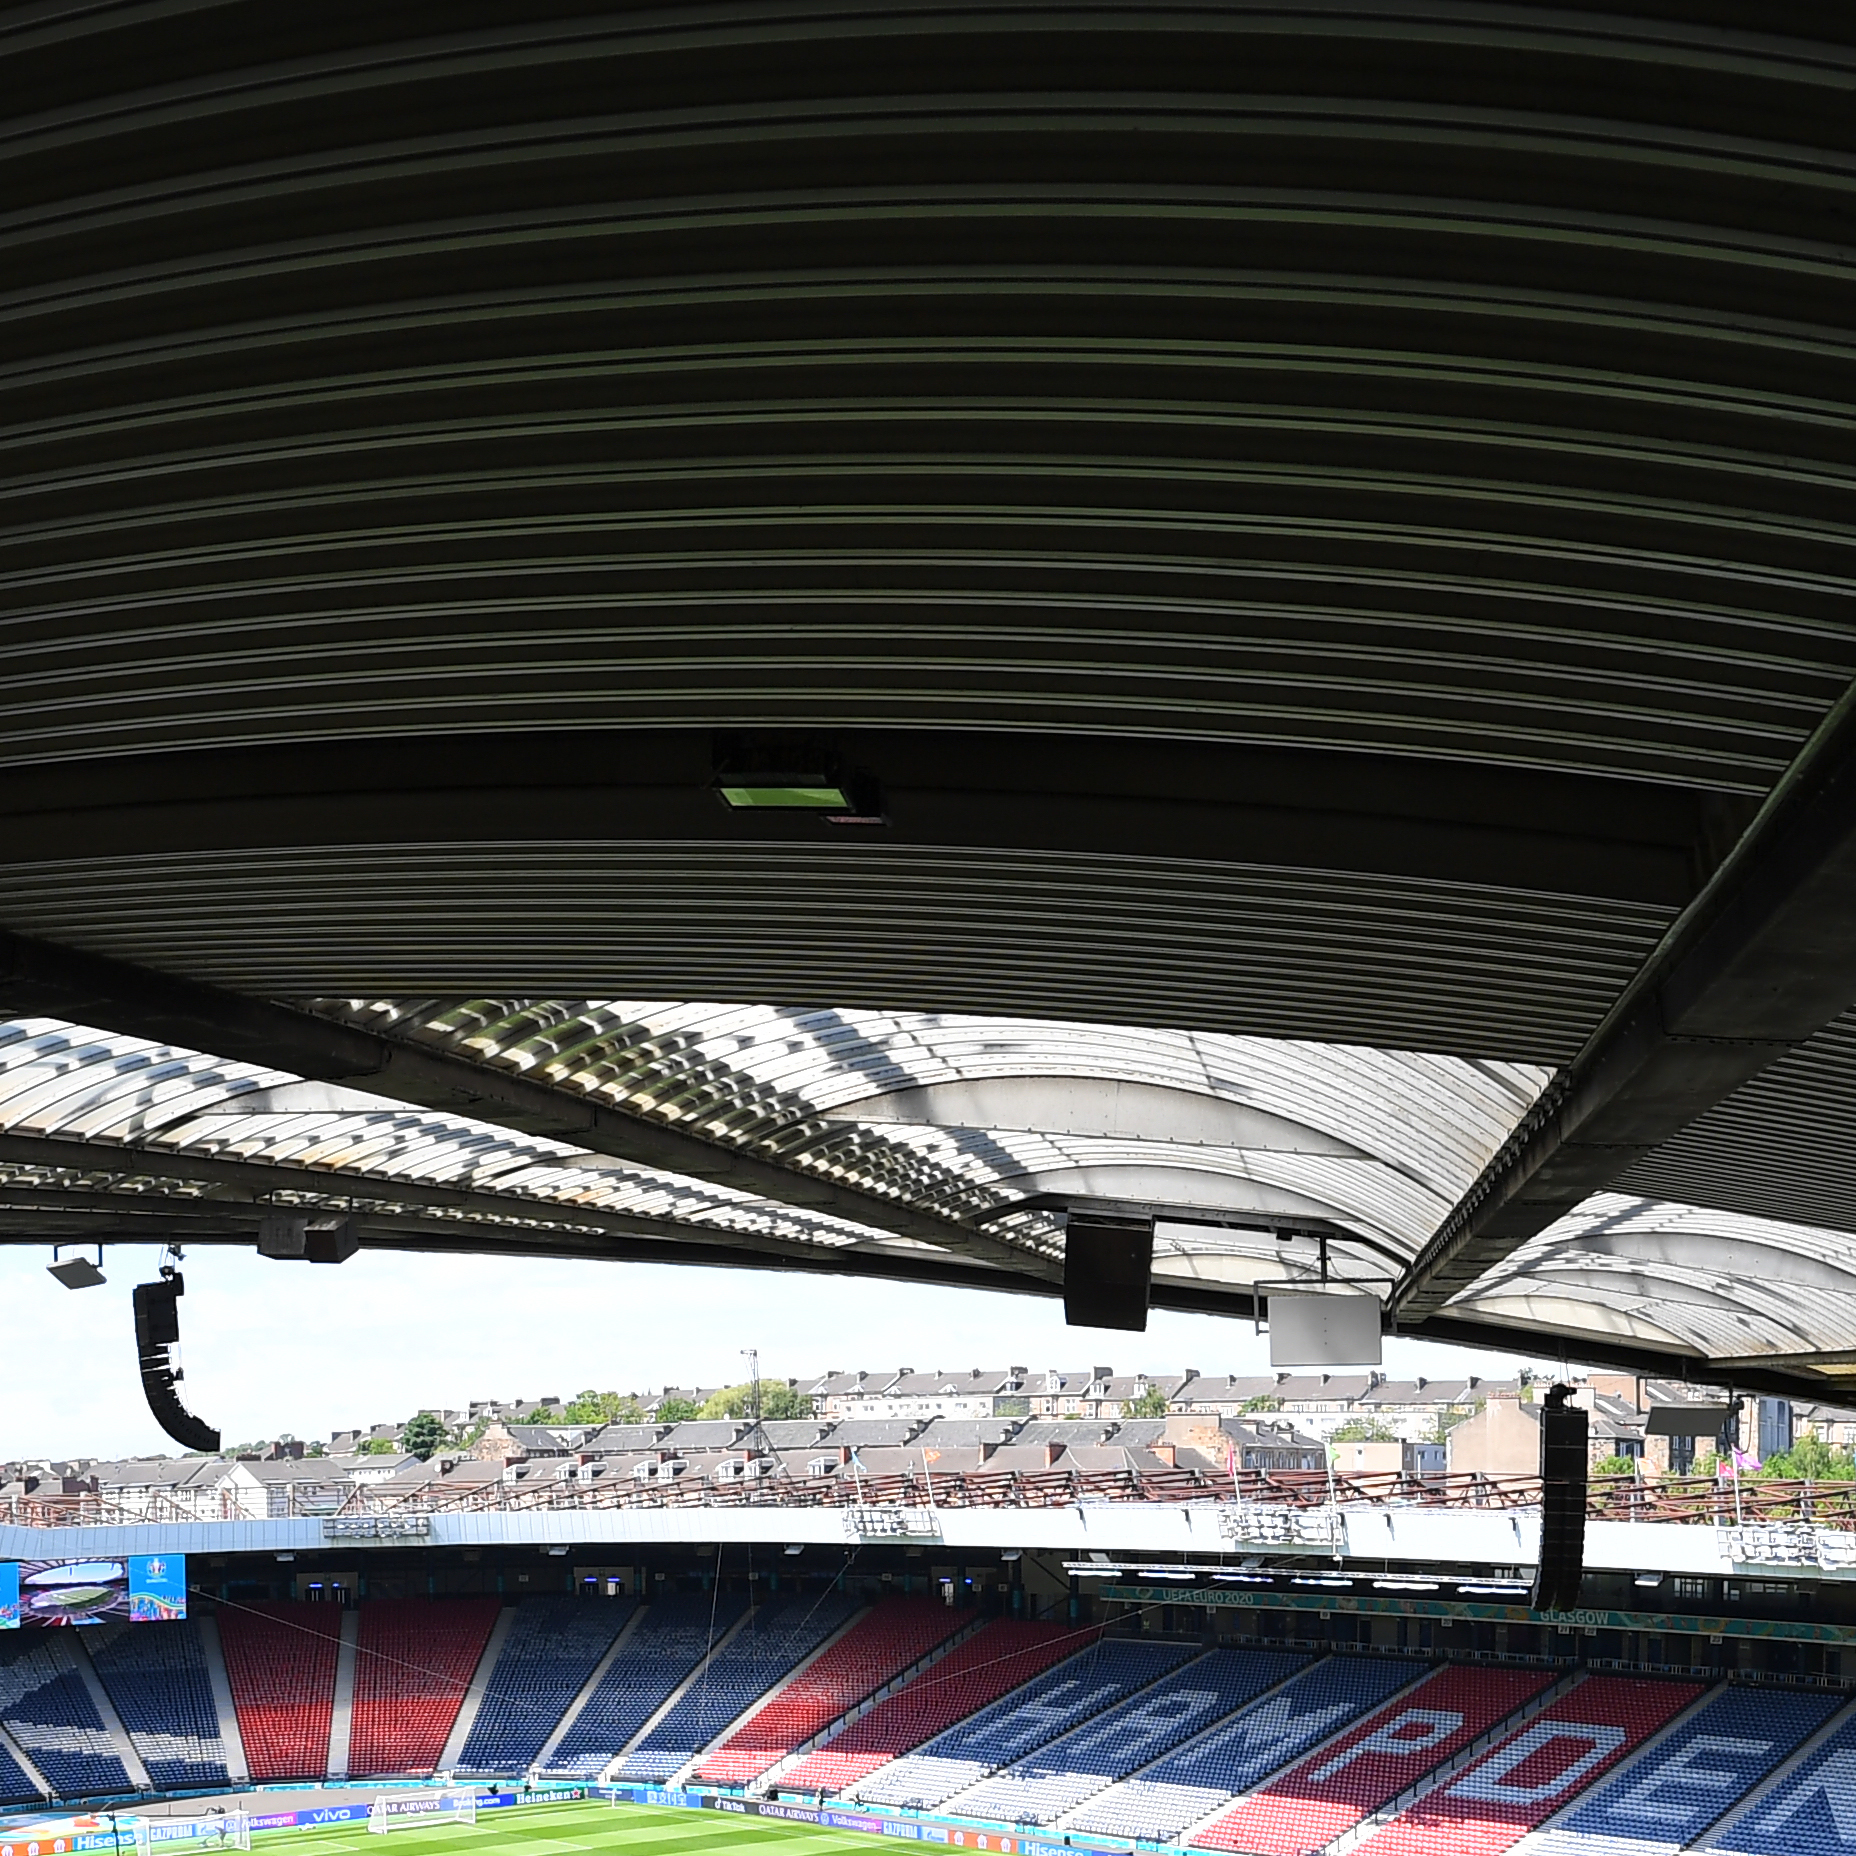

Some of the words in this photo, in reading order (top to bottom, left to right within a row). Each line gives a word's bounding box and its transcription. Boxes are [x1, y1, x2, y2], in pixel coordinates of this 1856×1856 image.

[1163, 1588, 1192, 1602] UEFA
[1194, 1590, 1224, 1604] EURO
[1225, 1591, 1254, 1605] 2020
[1540, 1609, 1609, 1626] GLASGOW
[516, 1789, 571, 1805] Heineken
[312, 1808, 351, 1822] vivo
[399, 1799, 440, 1814] AIRWAYS
[758, 1804, 785, 1818] QATAR
[785, 1808, 819, 1823] AIRWAYS
[831, 1814, 877, 1831] Volkswagen
